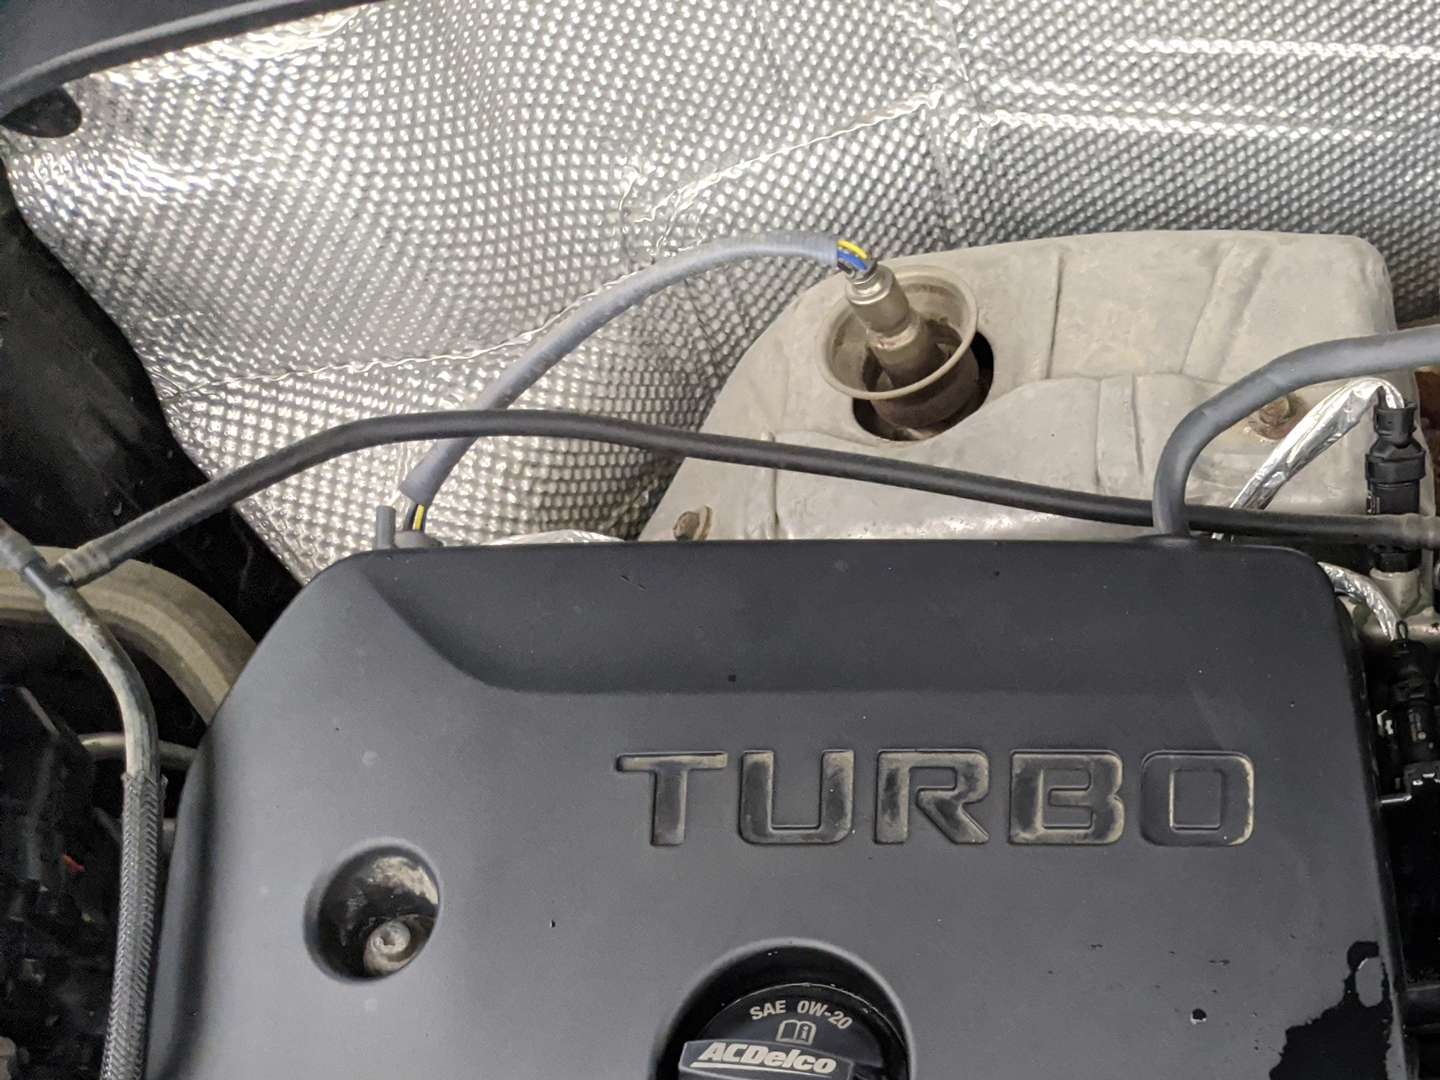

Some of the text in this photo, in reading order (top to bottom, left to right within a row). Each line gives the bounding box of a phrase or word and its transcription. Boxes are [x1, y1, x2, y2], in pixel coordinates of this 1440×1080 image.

[615, 749, 1256, 848] TURBO
[749, 999, 853, 1030] SAE 0W-20
[698, 1042, 837, 1075] ACDelco
